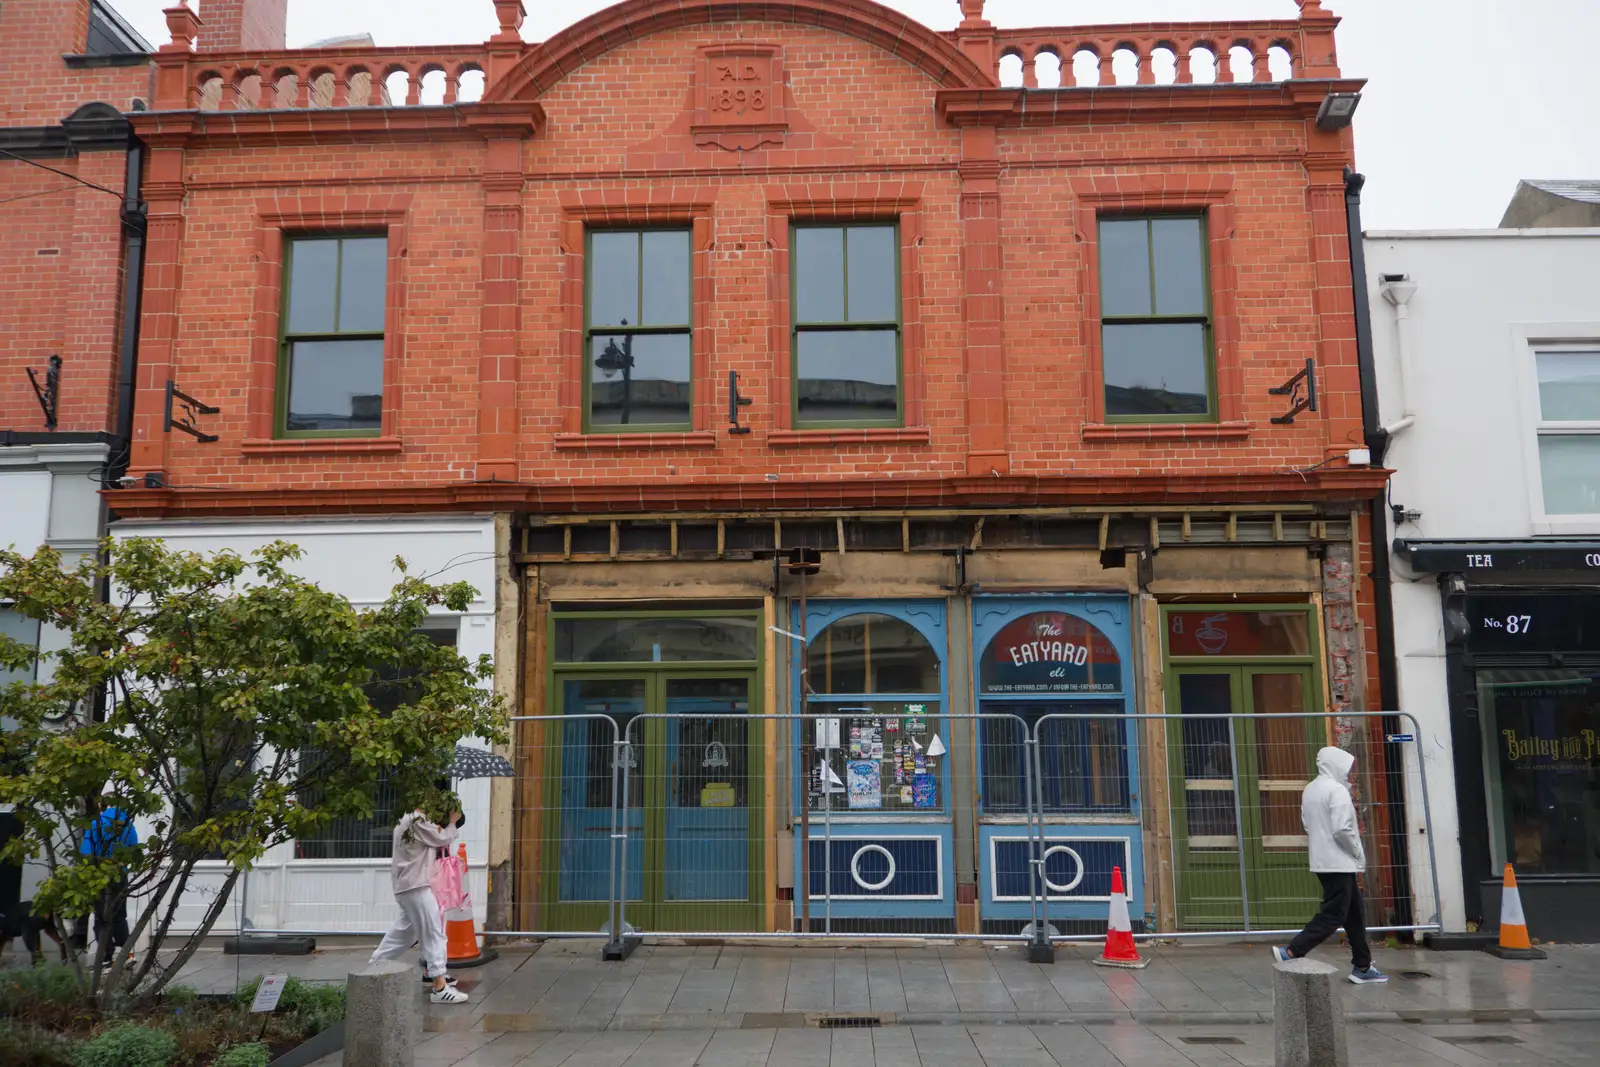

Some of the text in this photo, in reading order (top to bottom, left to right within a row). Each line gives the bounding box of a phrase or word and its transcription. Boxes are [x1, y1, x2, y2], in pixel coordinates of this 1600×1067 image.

[711, 88, 765, 116] 1898
[1466, 554, 1493, 567] TEA
[1039, 624, 1061, 637] The
[1483, 614, 1531, 634] No. 87
[1009, 640, 1089, 667] EATYARD
[1502, 729, 1560, 761] Bailey
